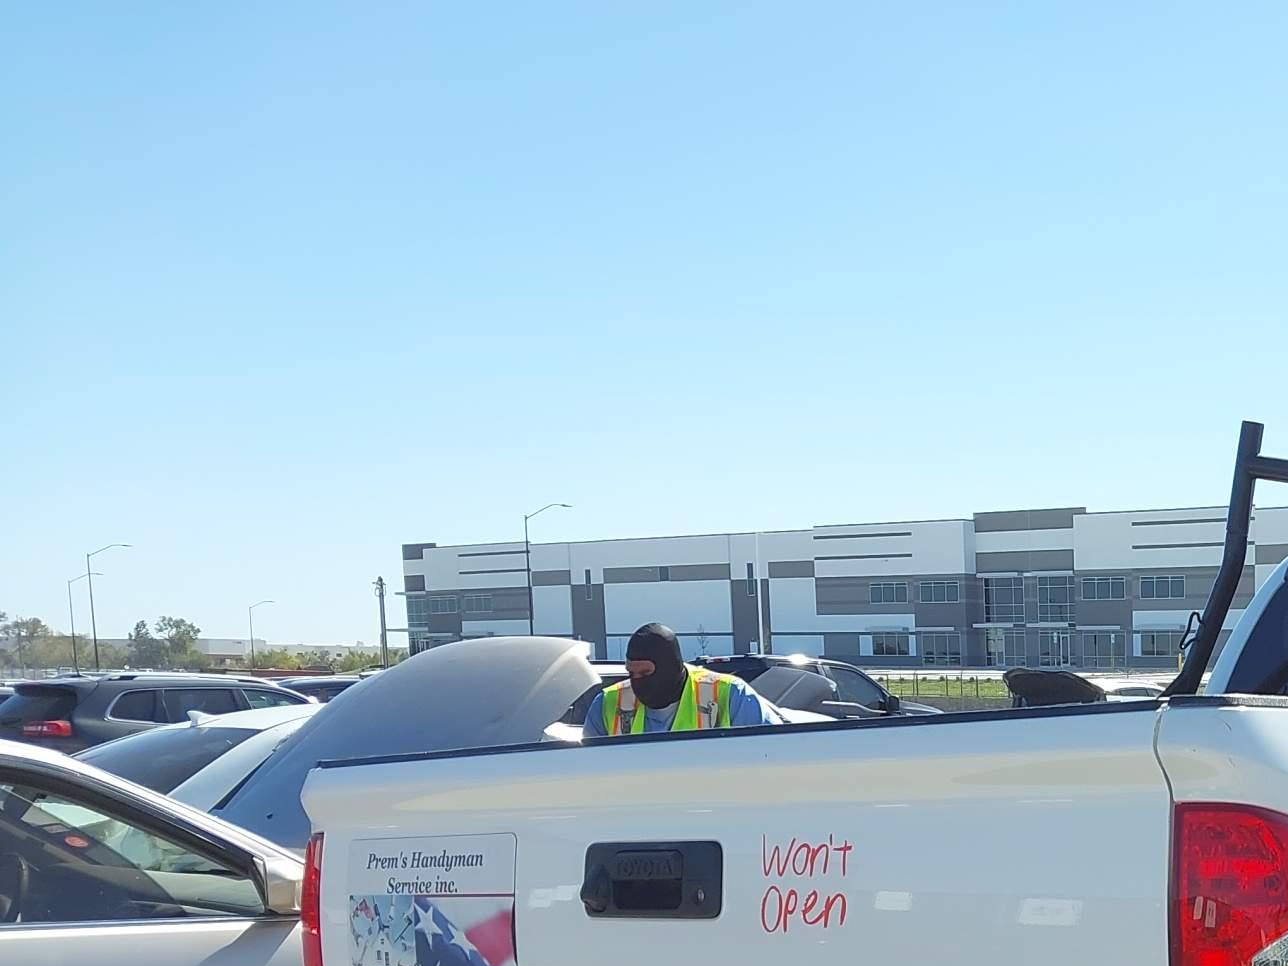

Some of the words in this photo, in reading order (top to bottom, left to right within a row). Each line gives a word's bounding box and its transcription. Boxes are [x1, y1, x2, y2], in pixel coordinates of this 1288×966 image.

[366, 851, 408, 870] Prem's
[410, 849, 484, 872] Handyman
[762, 833, 853, 878] Won't
[614, 857, 675, 878] TOYOTA
[386, 875, 432, 895] Service
[434, 875, 459, 894] inc.
[761, 885, 847, 933] Open
